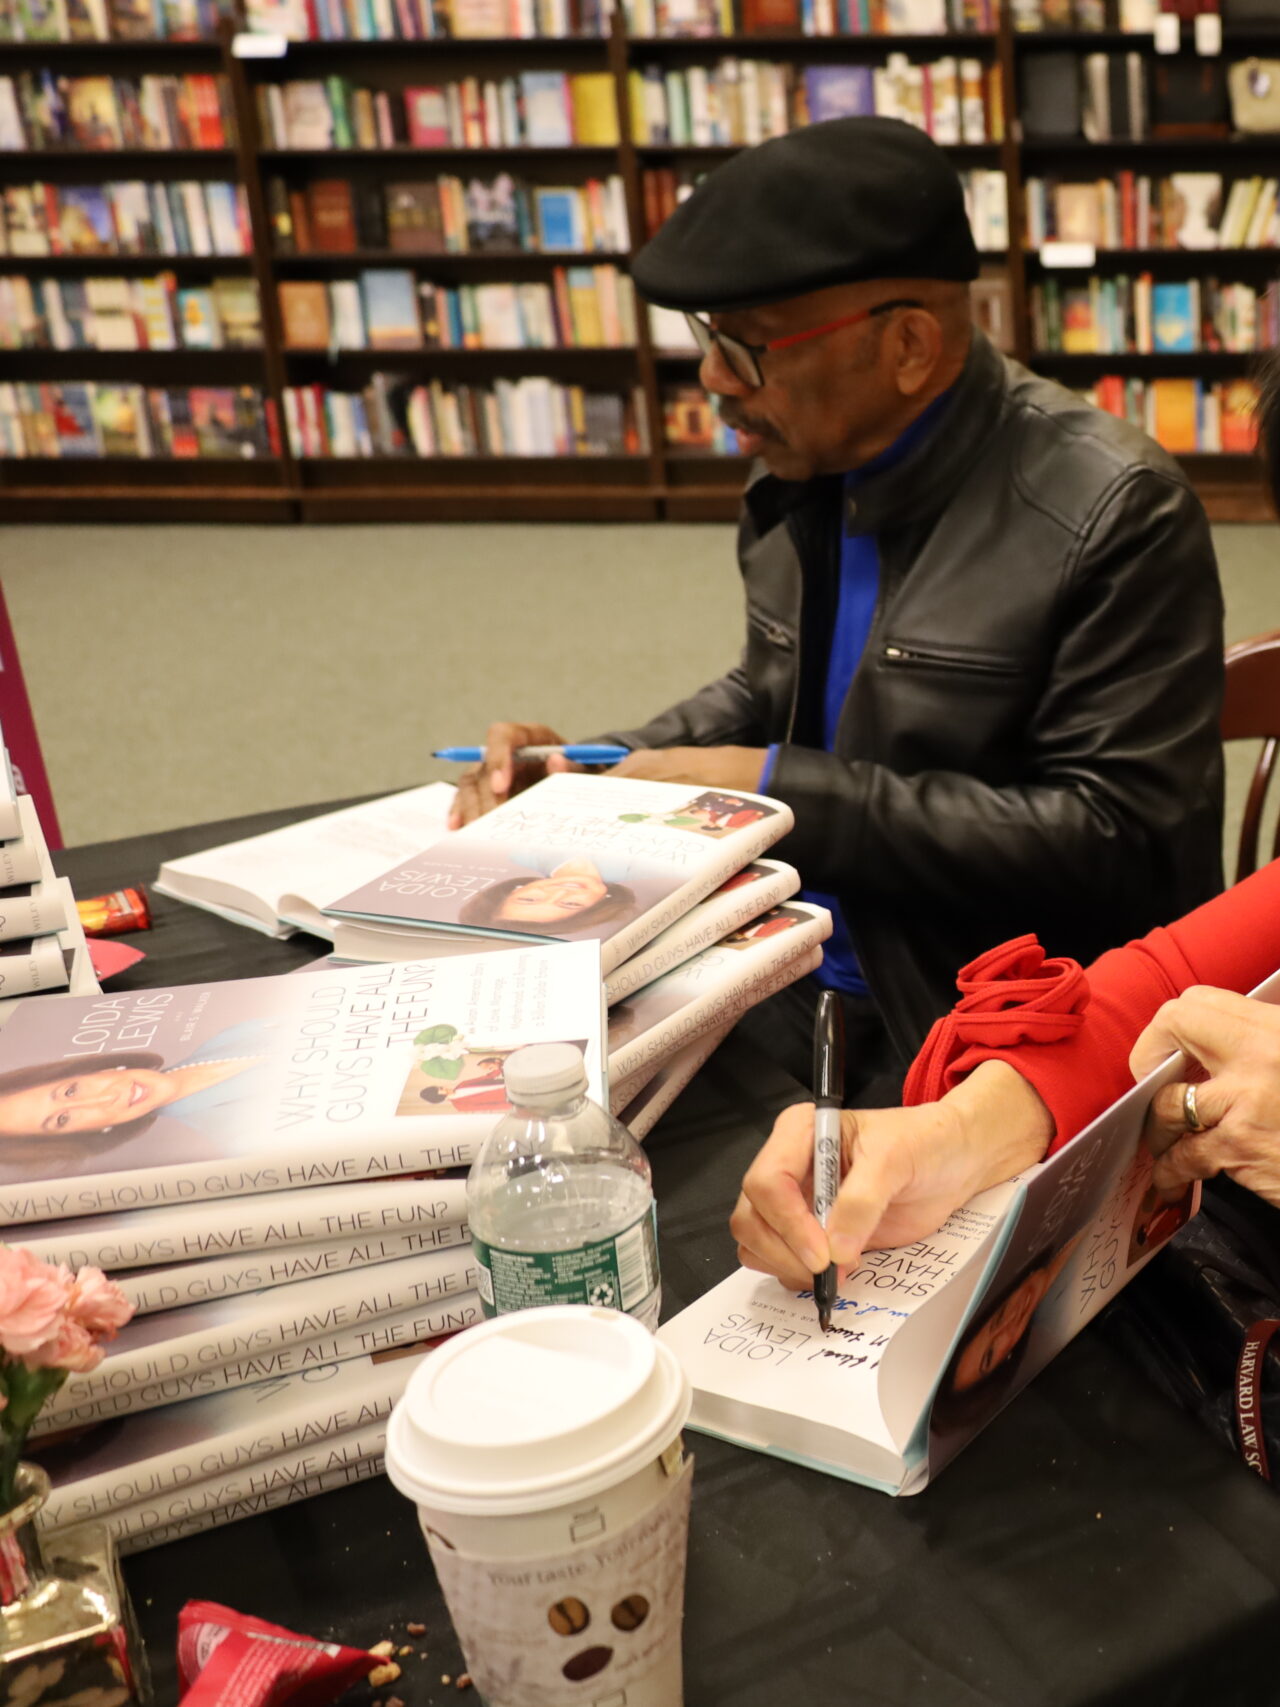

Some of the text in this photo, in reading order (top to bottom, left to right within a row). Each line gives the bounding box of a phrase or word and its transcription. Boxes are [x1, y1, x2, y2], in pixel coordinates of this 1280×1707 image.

[378, 880, 480, 901] LOIDA
[393, 869, 497, 890] LEWIS
[685, 926, 714, 949] HAVE
[714, 916, 734, 937] ALL
[735, 904, 755, 922] THE
[64, 997, 131, 1058] LOIDA
[111, 993, 174, 1052] LEWIS
[385, 963, 438, 1048] THE FUN?
[274, 985, 347, 1132] WHY SHOULD
[325, 968, 396, 1124] GUYS HAVE ALL
[616, 1048, 645, 1077] WHY
[1, 1194, 69, 1219] WHY
[78, 1178, 196, 1211] SHOULD
[205, 1168, 280, 1194] GUYS
[287, 1157, 359, 1184] HAVE
[366, 1152, 416, 1174] ALL
[420, 1143, 472, 1166] THE
[98, 1238, 175, 1265] GUYS
[183, 1227, 257, 1253] HAVE
[264, 1220, 315, 1243] ALL
[320, 1210, 373, 1234] THE
[381, 1200, 448, 1226] FUN?
[187, 1268, 262, 1298] GUYS
[270, 1250, 341, 1281] HAVE
[348, 1241, 397, 1265] ALL
[401, 1226, 451, 1251] THE
[904, 1241, 960, 1265] THE
[867, 1251, 945, 1280] HAVE
[69, 1353, 189, 1400] SHOULD
[197, 1328, 272, 1367] GUYS
[279, 1305, 349, 1341] HAVE
[356, 1293, 404, 1319] ALL
[408, 1273, 457, 1301] THE
[140, 1371, 216, 1401] GUYS
[223, 1351, 295, 1384] HAVE
[301, 1340, 351, 1365] ALL
[354, 1324, 405, 1350] THE
[413, 1307, 477, 1337] FUN?
[703, 1328, 793, 1366] LOIDA
[720, 1313, 812, 1350] LEWIS
[1239, 1340, 1261, 1410] HARVARD
[73, 1464, 192, 1510] SHOULD
[200, 1436, 274, 1473] GUYS
[281, 1410, 349, 1447] HAVE
[1240, 1411, 1258, 1450] LAW
[168, 1481, 242, 1520] GUYS
[249, 1456, 319, 1494] HAVE
[326, 1442, 372, 1470] ALL
